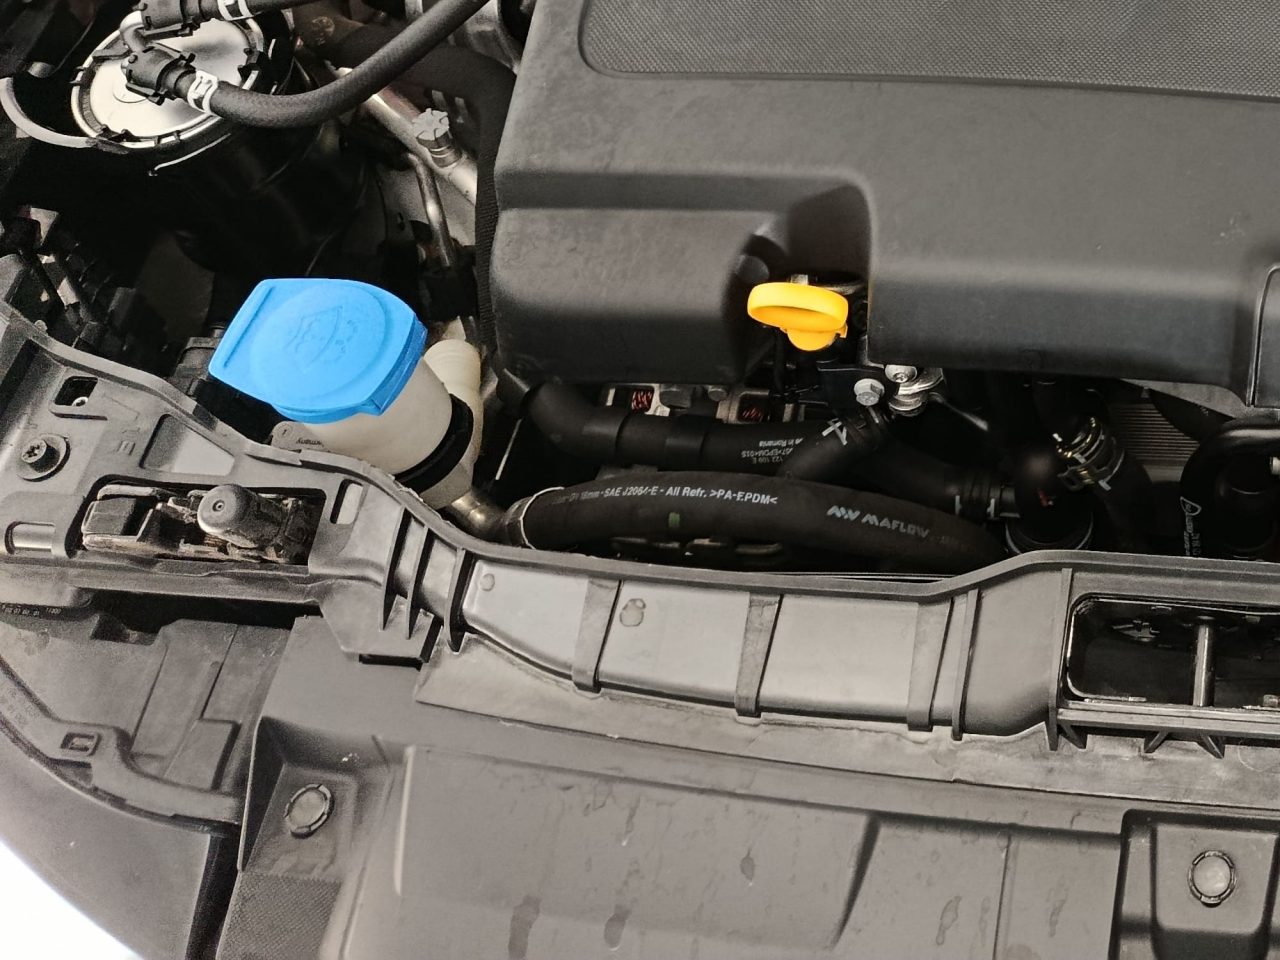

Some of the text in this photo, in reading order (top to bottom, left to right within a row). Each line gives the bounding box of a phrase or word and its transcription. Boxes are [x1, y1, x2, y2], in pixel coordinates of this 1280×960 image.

[604, 487, 622, 498] SAE
[665, 486, 680, 497] All
[681, 486, 707, 497] Refr.
[861, 513, 930, 538] MAFLOW
